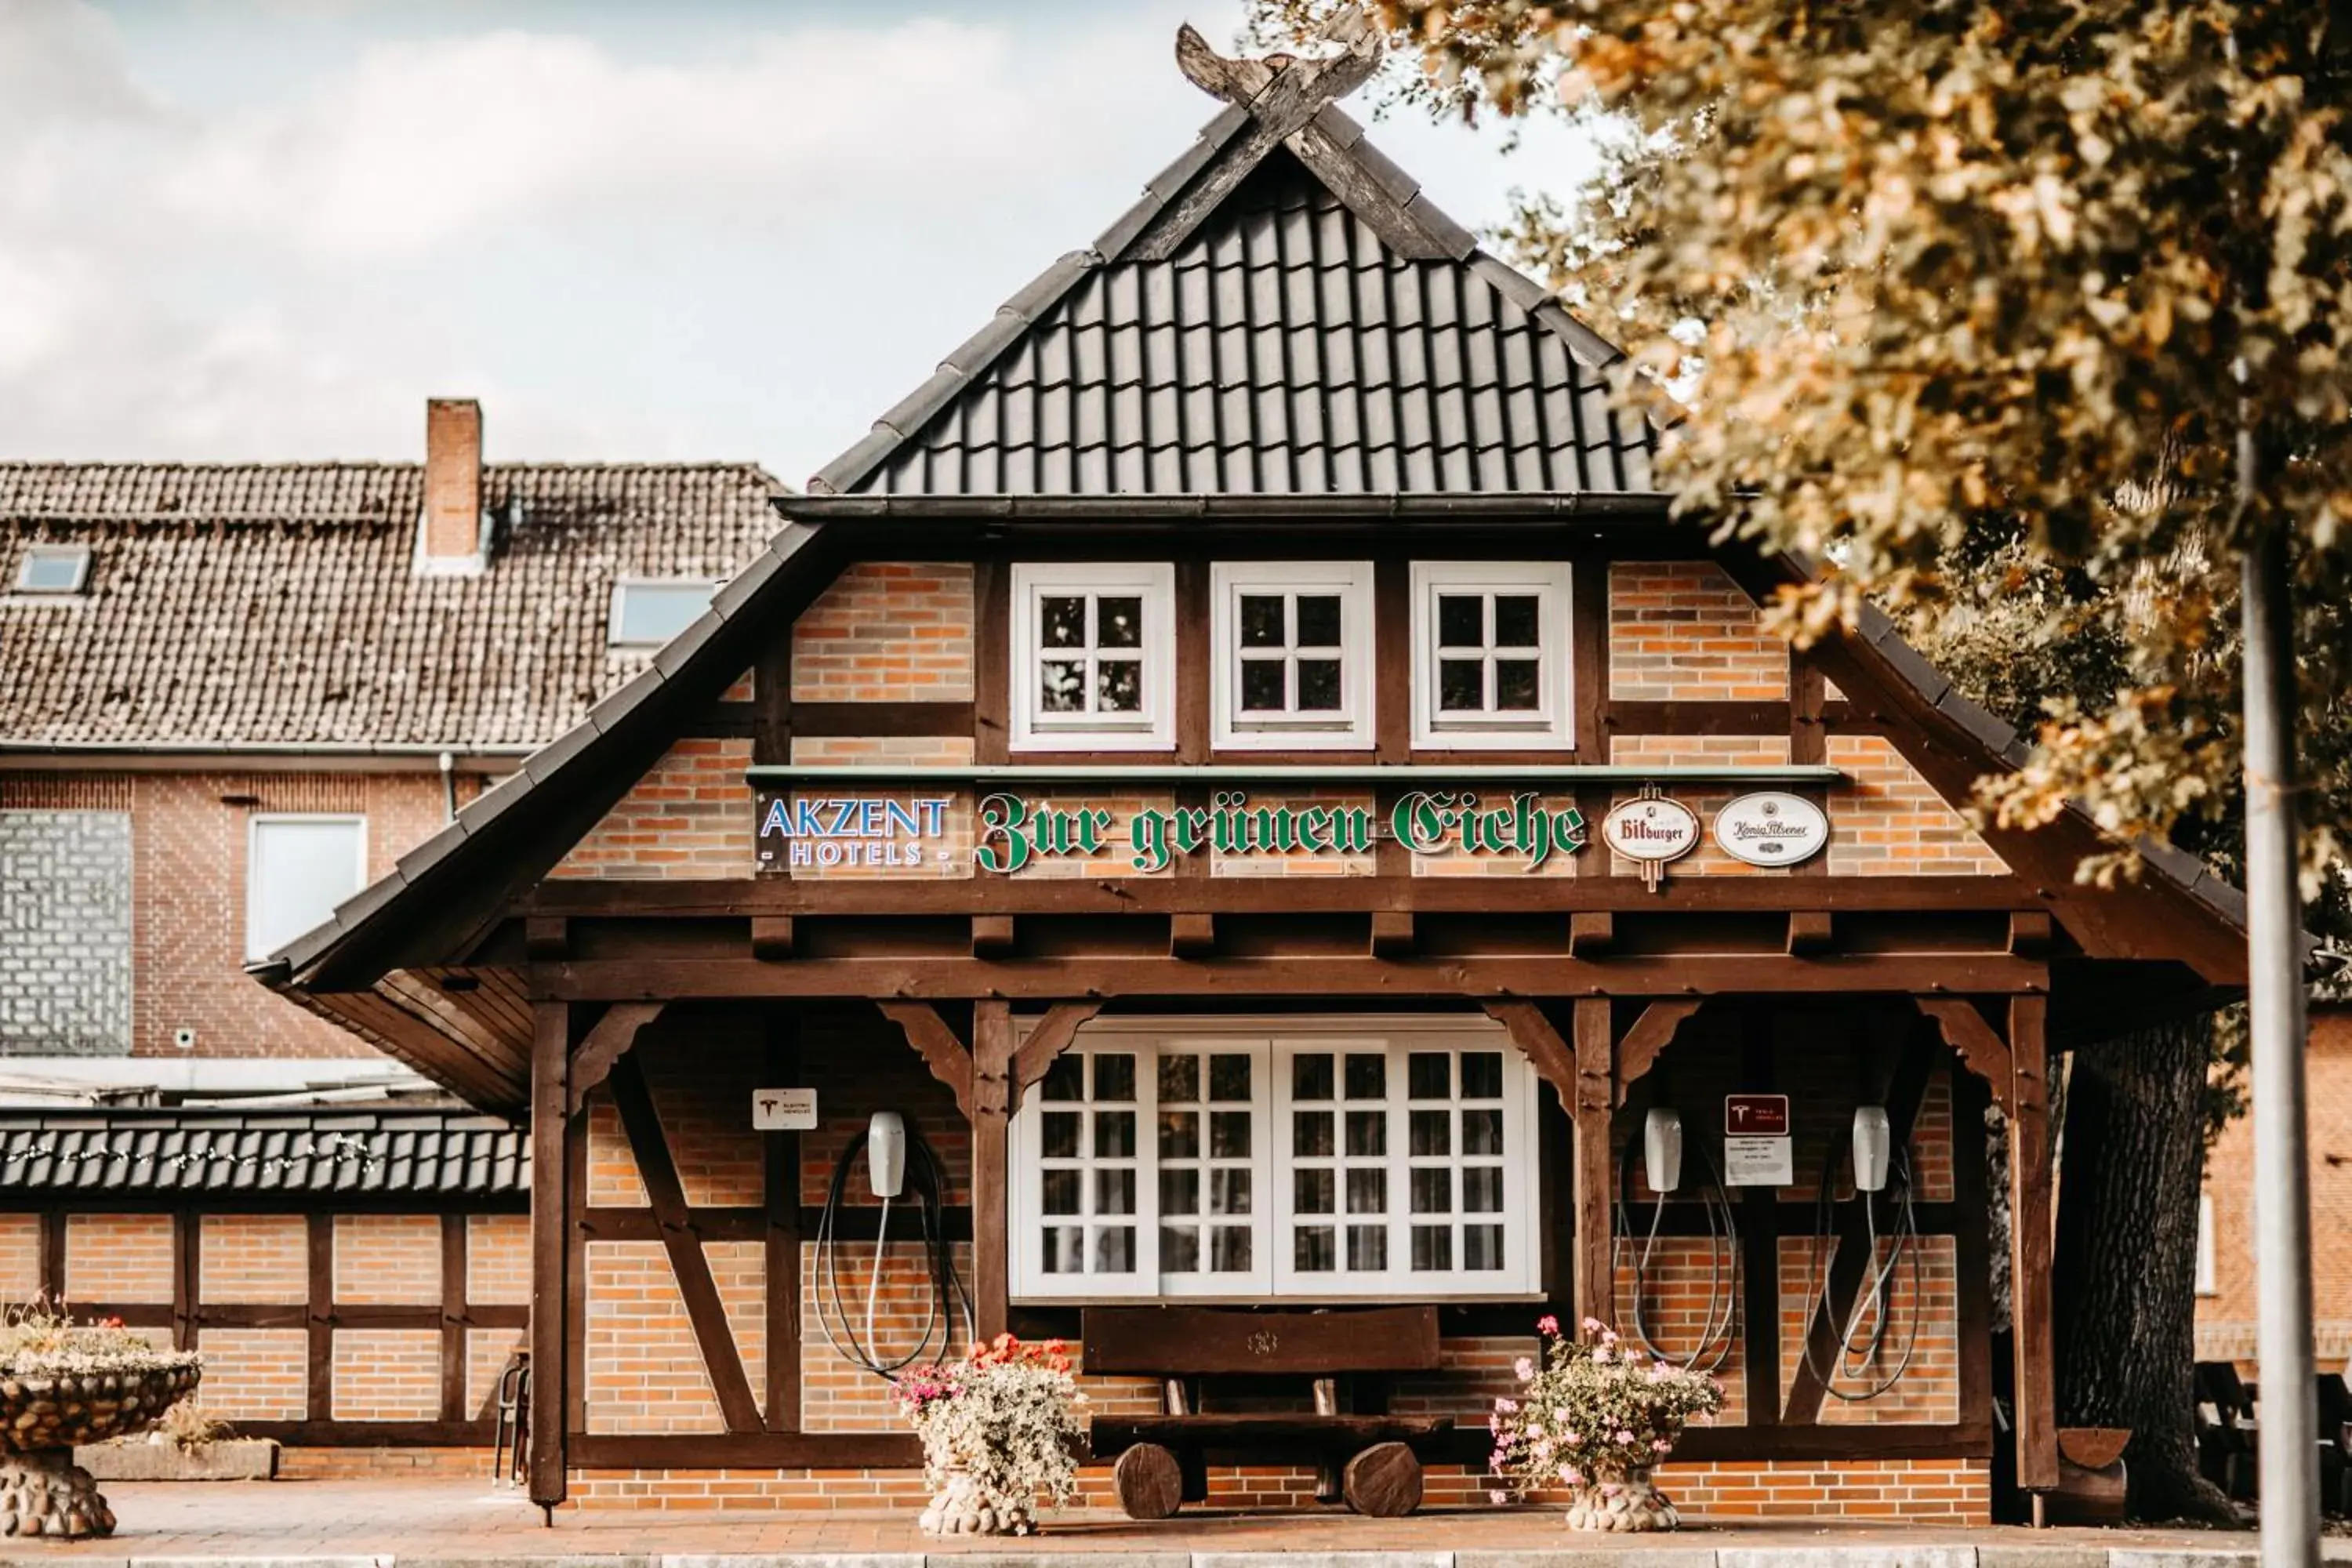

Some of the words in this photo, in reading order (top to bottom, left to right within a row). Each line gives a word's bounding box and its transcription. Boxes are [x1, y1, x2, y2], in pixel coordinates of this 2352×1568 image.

[760, 798, 950, 837] AKZENT
[973, 793, 1111, 873] Zur
[1130, 791, 1374, 872] grünen
[1392, 791, 1585, 872] Eiche
[1621, 819, 1683, 842] Bitburger
[789, 842, 921, 866] HOTELS
